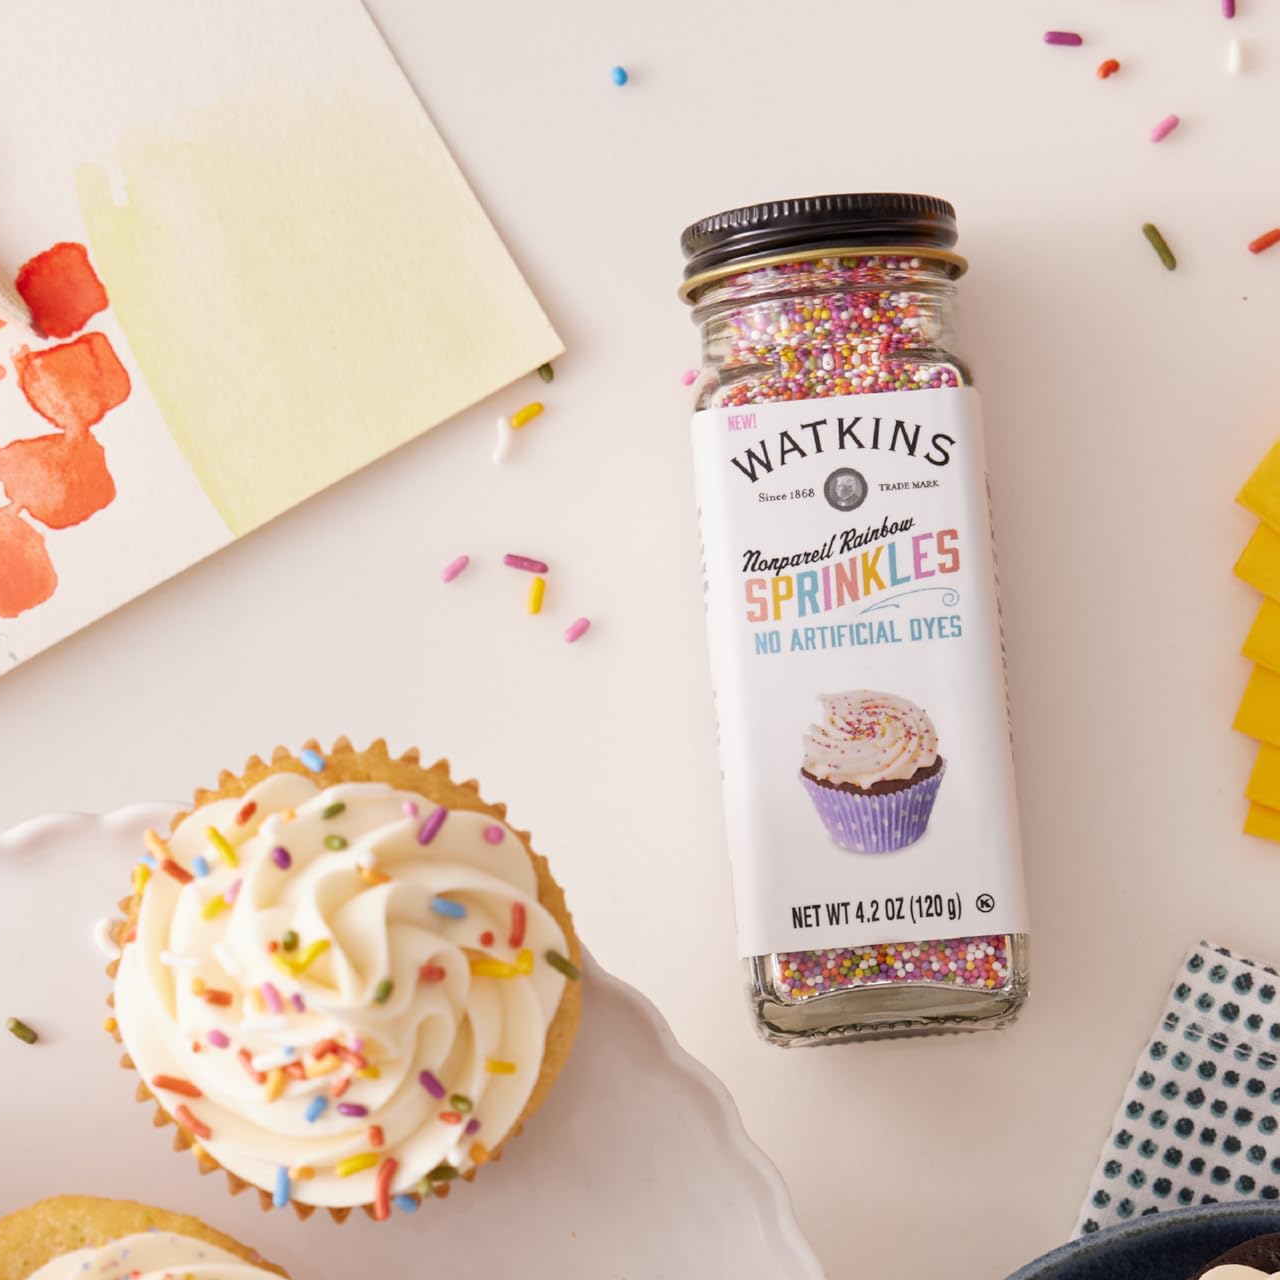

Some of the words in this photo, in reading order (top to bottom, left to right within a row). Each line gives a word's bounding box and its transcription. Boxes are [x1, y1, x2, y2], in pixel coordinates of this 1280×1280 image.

[727, 413, 757, 431] NEW!
[730, 416, 957, 483] WATKINS
[758, 490, 787, 503] Since
[789, 488, 816, 500] 1868
[878, 481, 910, 493] TRADE
[911, 479, 940, 491] MARK
[741, 533, 834, 577] Nonpareil
[839, 515, 917, 555] Rainbow
[744, 528, 961, 623] SPRINKLES
[754, 630, 782, 655] NO
[789, 619, 903, 652] ARTIFICIAL
[910, 615, 963, 642] DYES
[791, 903, 822, 929] NET
[826, 901, 851, 926] WT
[855, 899, 880, 924] 4.2
[884, 897, 906, 922] OZ
[910, 893, 944, 924] (120
[948, 892, 963, 921] g)
